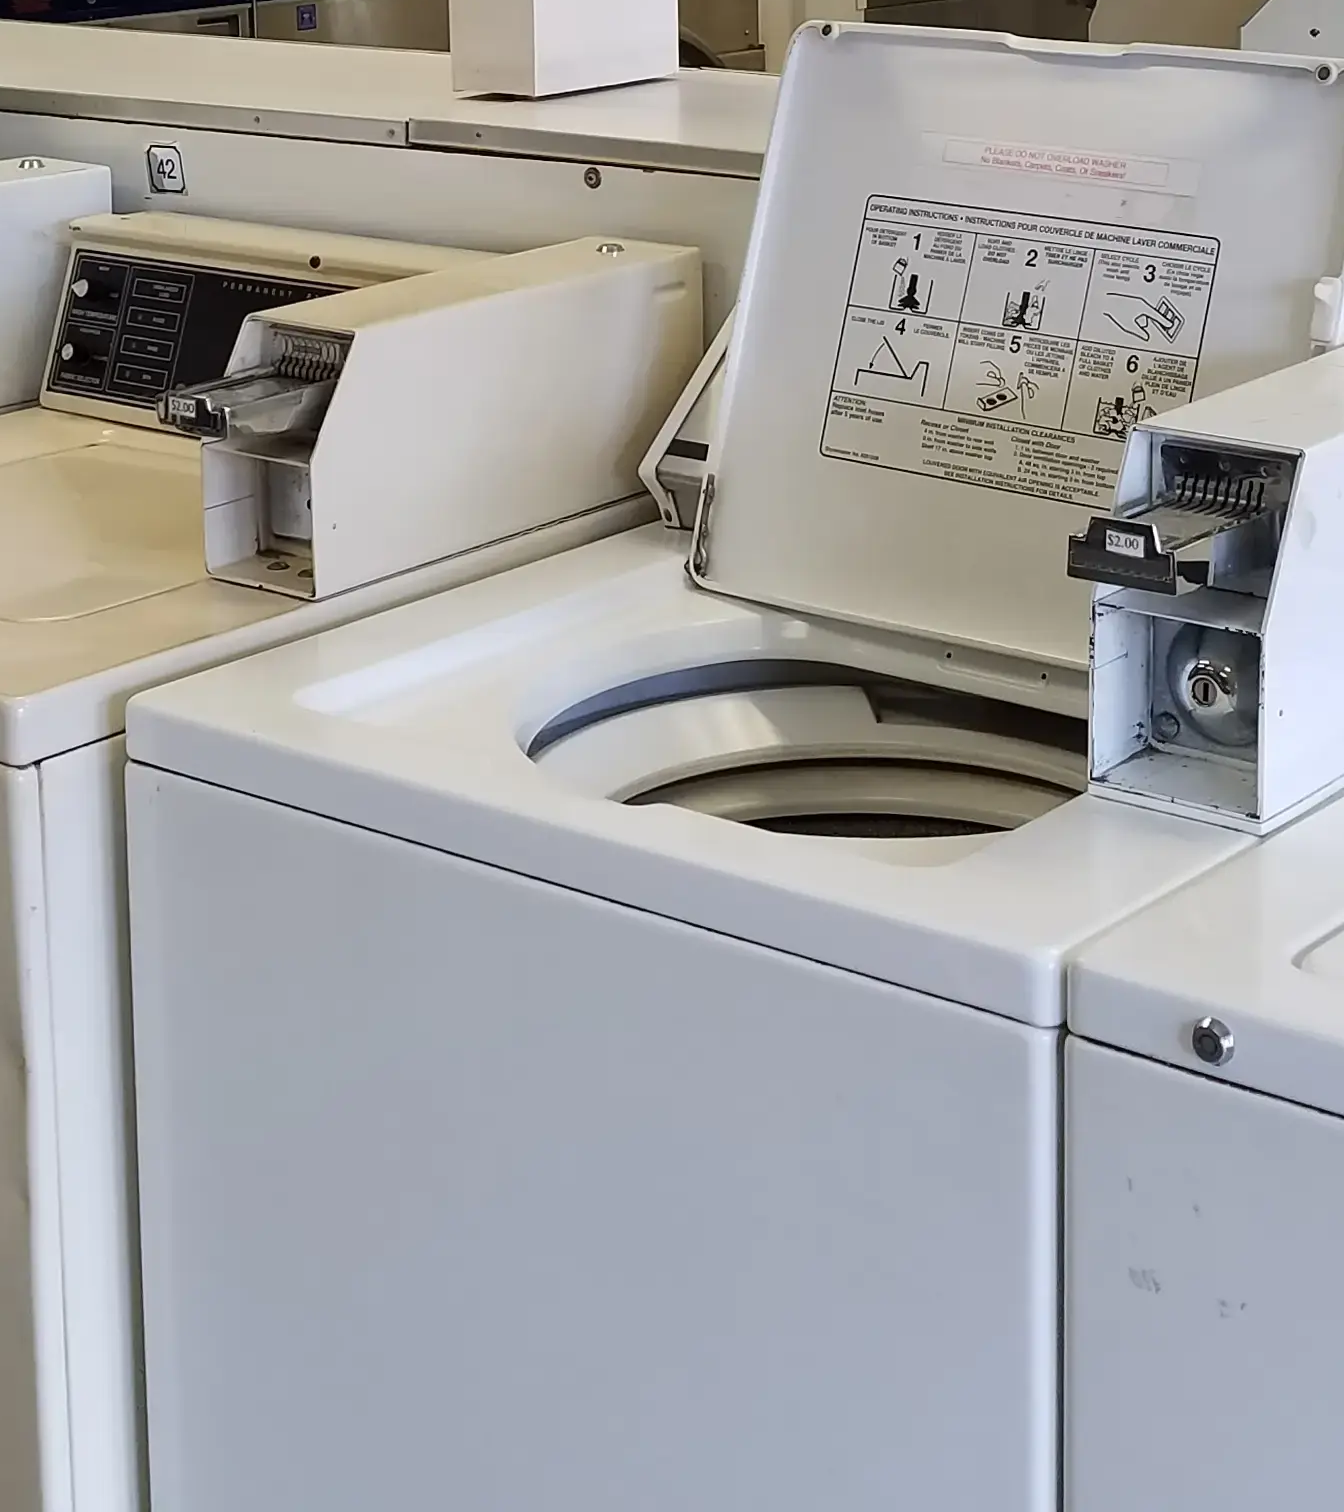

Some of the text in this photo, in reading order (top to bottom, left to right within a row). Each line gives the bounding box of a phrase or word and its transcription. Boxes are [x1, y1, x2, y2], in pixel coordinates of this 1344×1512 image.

[157, 160, 177, 180] 42
[870, 204, 1215, 256] OPERATING INSTRUCTIONS INSTRUCTIONS POUR COUVERCLE DE MACHINE LAVER COMMERCIALE
[913, 233, 922, 250] 1
[1025, 249, 1038, 267] 2
[1143, 264, 1157, 283] 3
[895, 318, 906, 335] 4
[1009, 336, 1022, 353] 5
[1127, 355, 1140, 373] 6
[1107, 533, 1139, 550] $2.00
